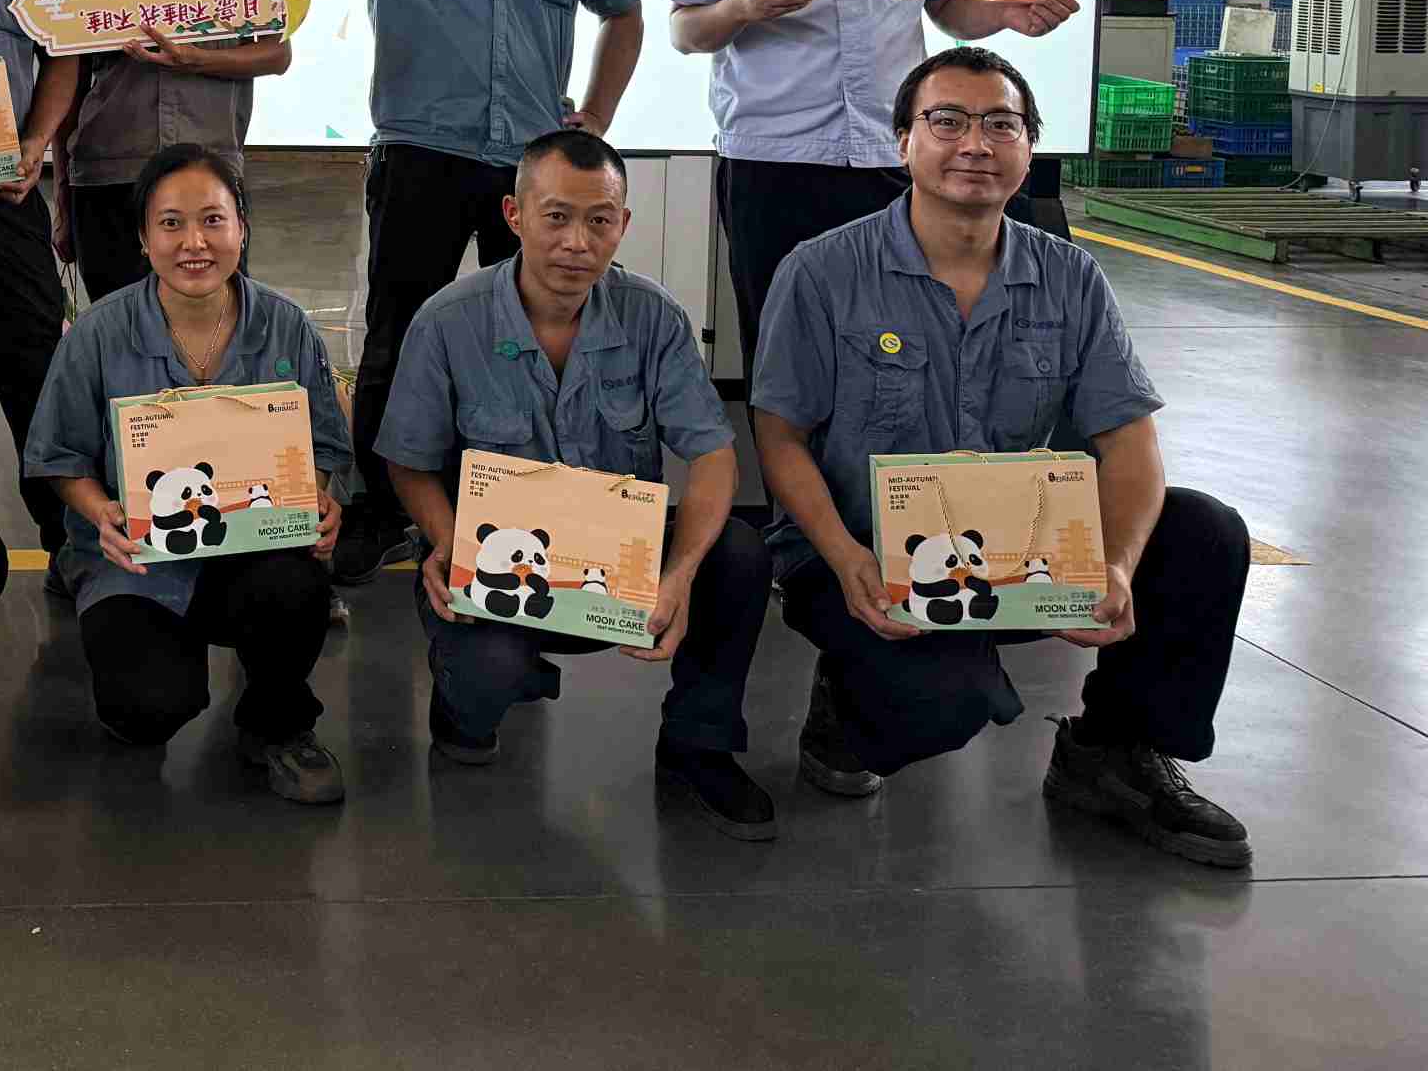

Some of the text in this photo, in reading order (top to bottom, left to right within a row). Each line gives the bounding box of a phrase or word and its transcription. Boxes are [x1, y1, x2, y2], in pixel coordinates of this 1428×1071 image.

[130, 423, 158, 431] FESTIVAL
[471, 471, 501, 482] FESTIVAL
[888, 484, 921, 492] FESTIVAL
[258, 526, 285, 537] MOON
[287, 523, 311, 534] CAKE
[1035, 603, 1067, 613] MOON
[585, 613, 616, 627] MOON
[618, 619, 645, 631] CAKE
